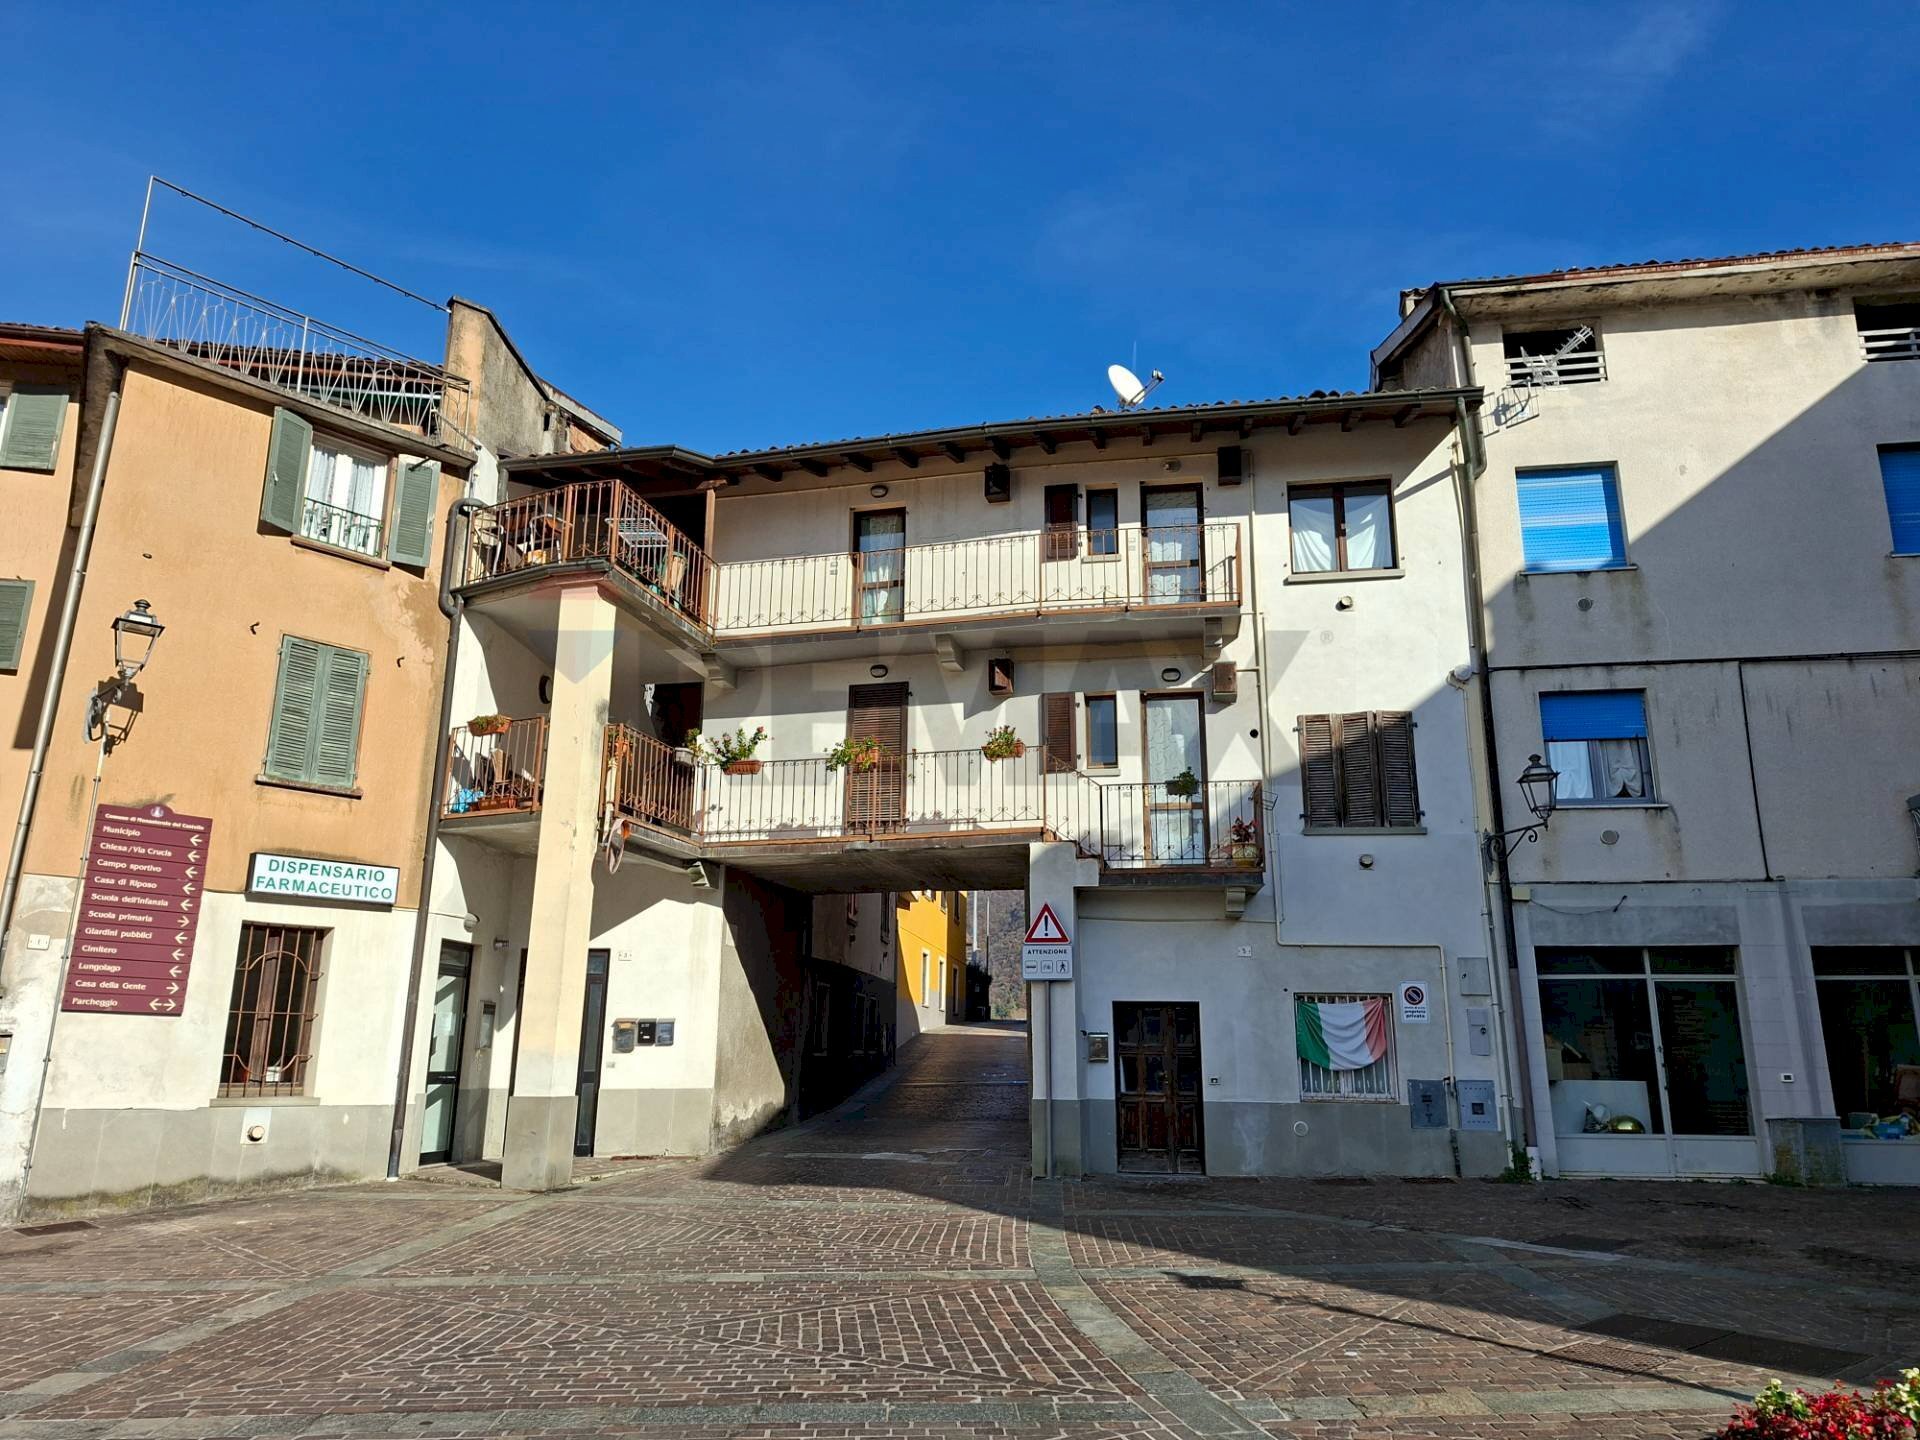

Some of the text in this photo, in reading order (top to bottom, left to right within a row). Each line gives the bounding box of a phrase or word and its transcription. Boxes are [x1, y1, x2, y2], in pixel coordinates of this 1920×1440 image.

[102, 825, 141, 837] Municipio
[147, 848, 173, 857] Crucis
[97, 859, 162, 873] Campo sportivo
[268, 859, 385, 882] DISPENSARIO
[94, 876, 158, 889] Casa di Riposo
[256, 875, 393, 900] FARMACEUTICO
[91, 893, 119, 903] Scuola
[88, 910, 153, 922] Scuola primaria
[85, 927, 153, 939] Giardini pubblici
[81, 944, 118, 954] Cimitero
[78, 962, 121, 973] Lungolago
[75, 980, 147, 991] Casa della Gente
[72, 997, 118, 1008] Parcheggio
